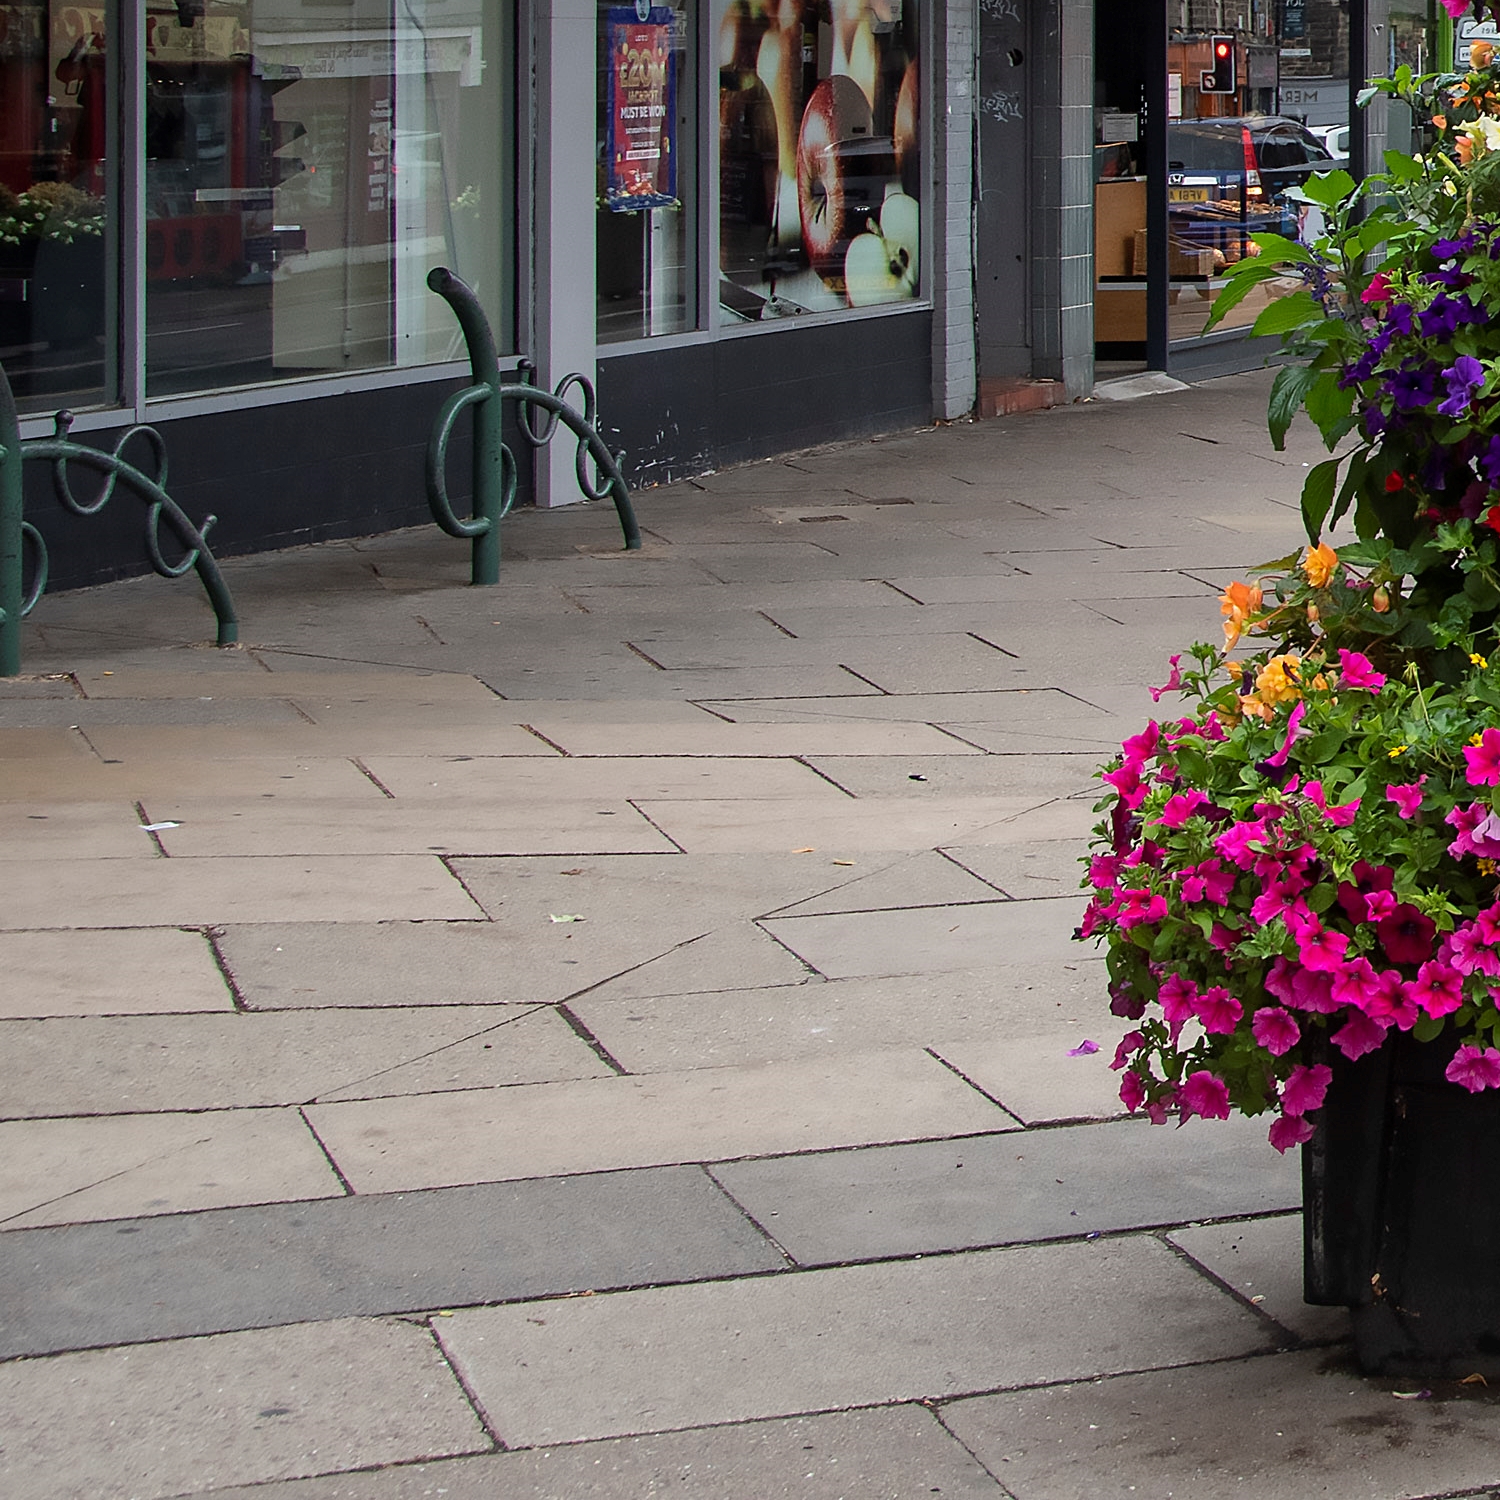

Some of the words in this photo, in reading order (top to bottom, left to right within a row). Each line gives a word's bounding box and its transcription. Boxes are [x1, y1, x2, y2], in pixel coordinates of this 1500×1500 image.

[620, 106, 639, 120] MUST
[639, 106, 649, 118] BE
[649, 104, 666, 118] WON
